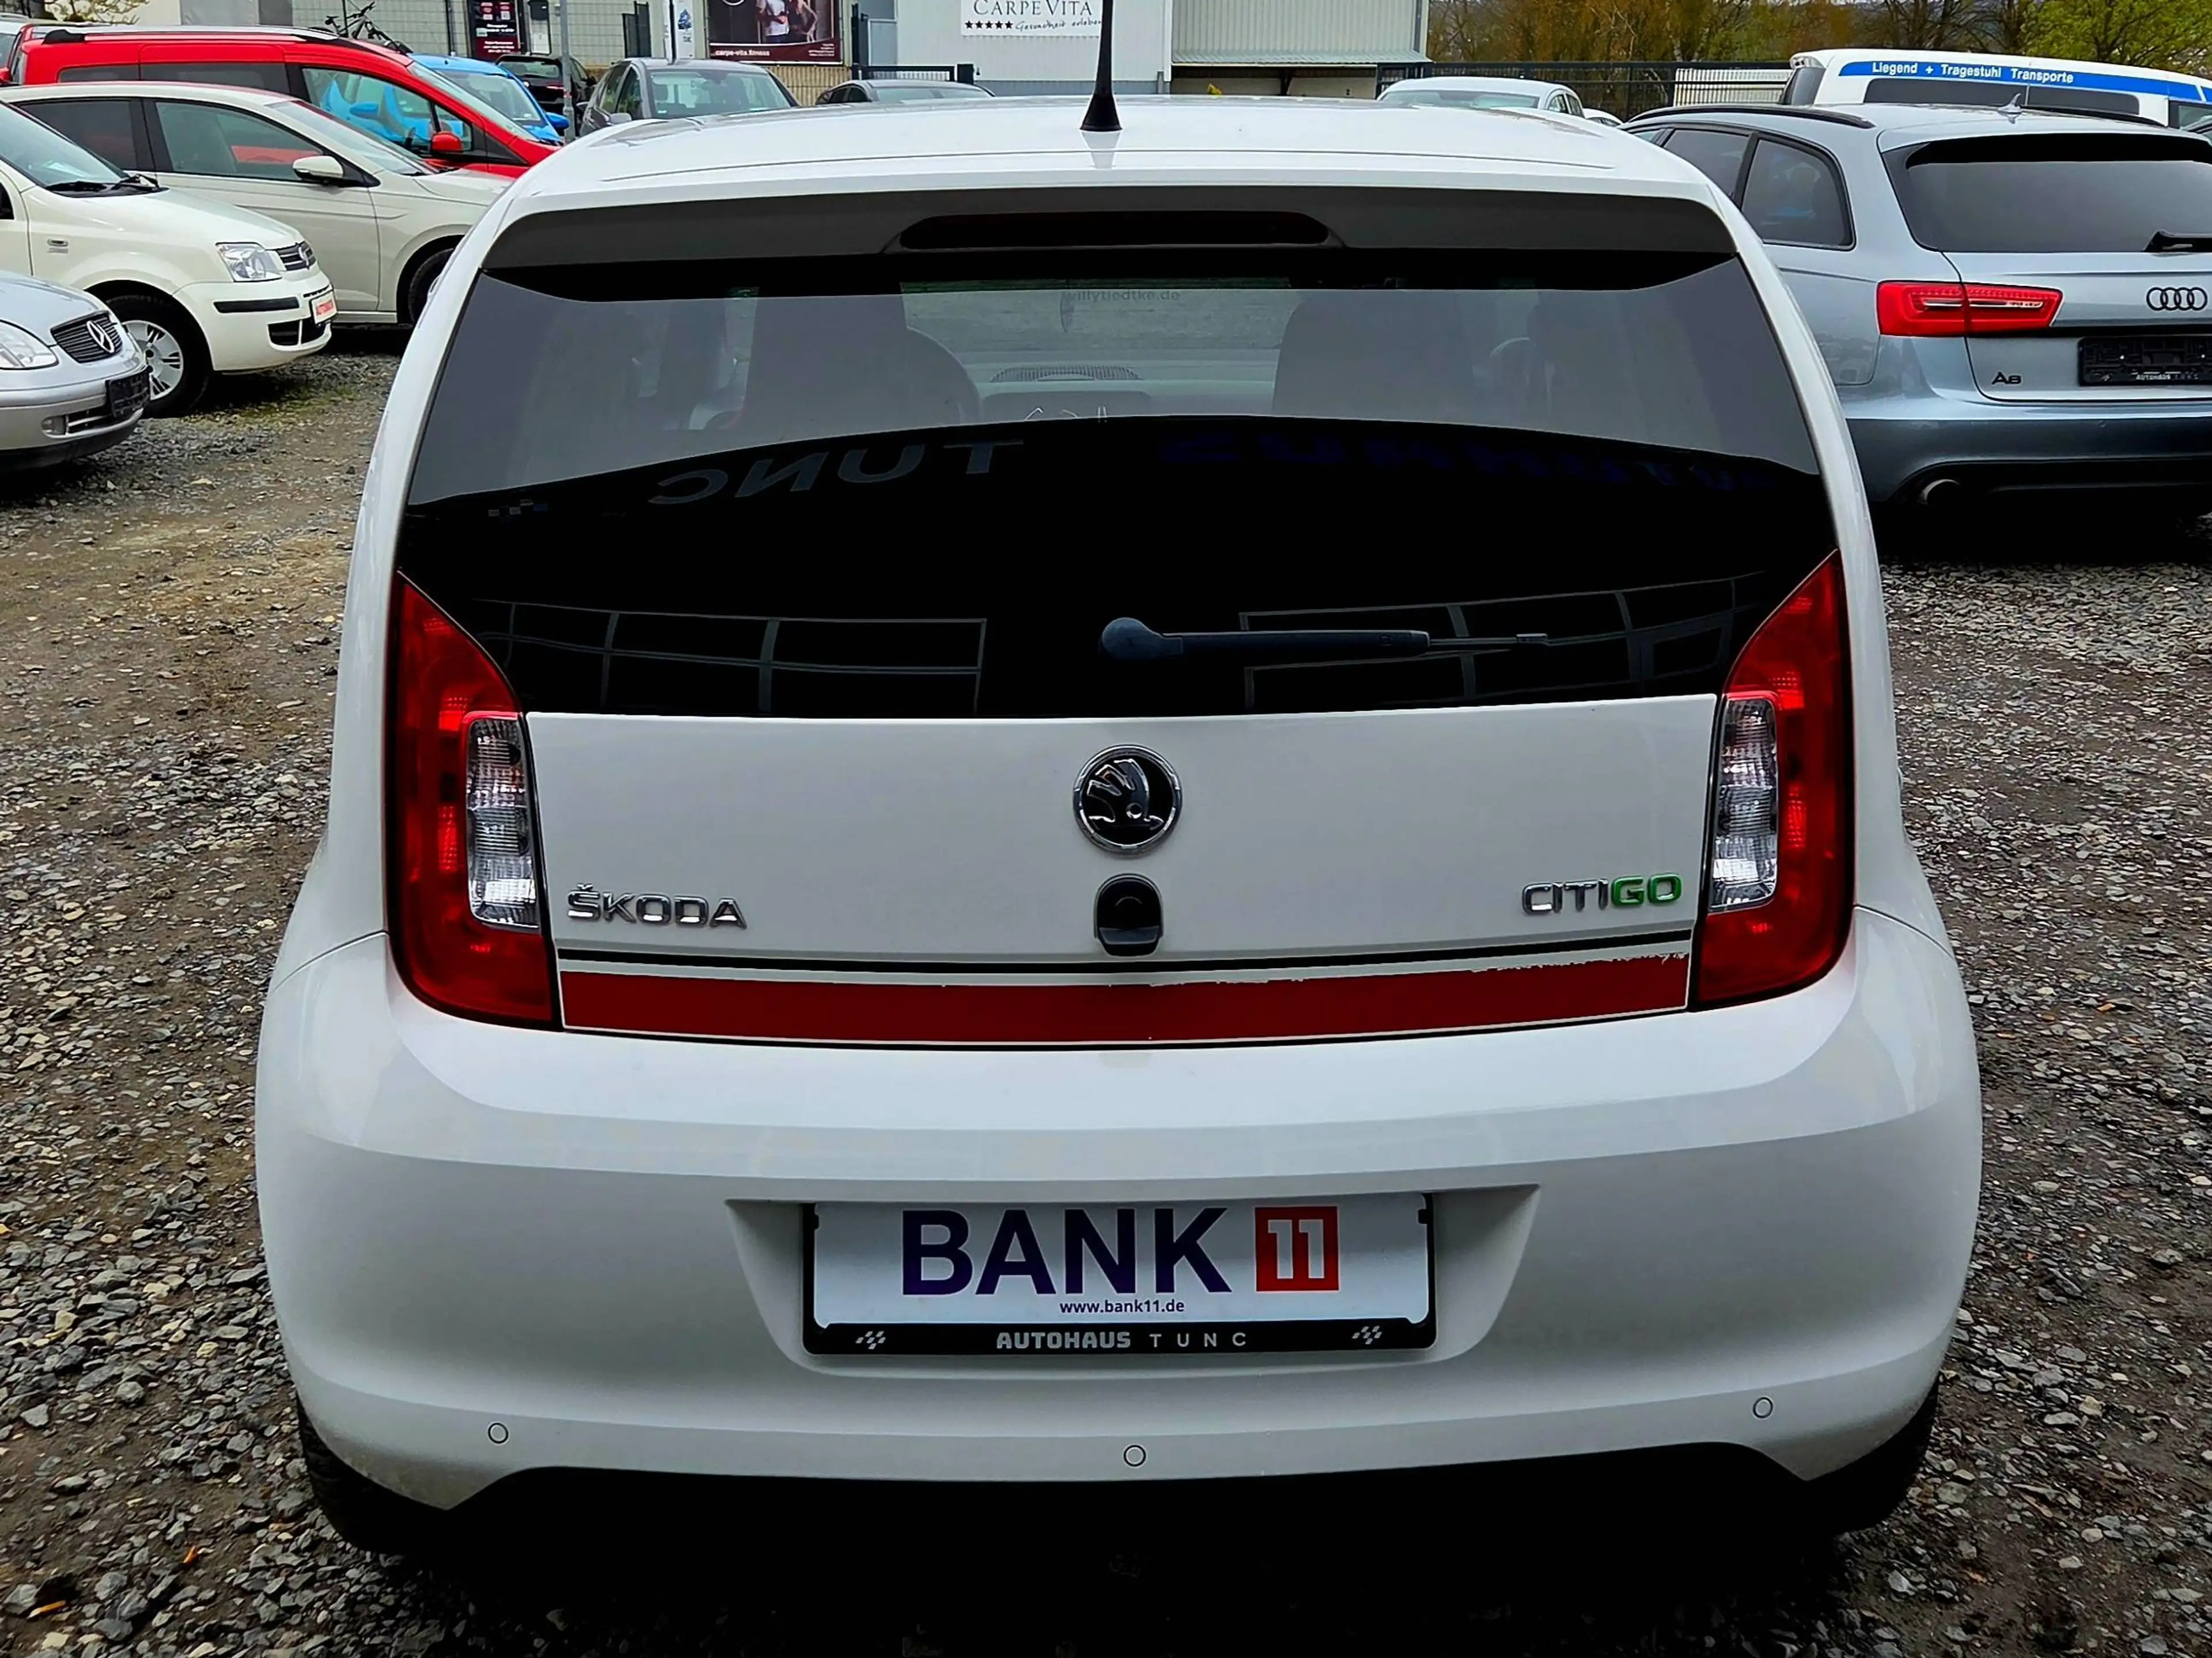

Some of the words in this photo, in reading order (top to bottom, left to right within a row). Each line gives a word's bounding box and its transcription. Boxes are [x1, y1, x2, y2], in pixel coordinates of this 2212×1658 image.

[1872, 62, 1918, 76] Liegend
[1941, 63, 2001, 78] Tragestuhl
[2010, 67, 2074, 84] Transporte
[567, 882, 747, 929] ŠKODA
[1522, 872, 1682, 915] CITIGO
[902, 1207, 1233, 1296] BANK
[1267, 1219, 1324, 1279] 11
[1059, 1299, 1185, 1314] www.bank11.de
[997, 1331, 1131, 1349] AUTOHAUS
[1149, 1332, 1247, 1348] TUNC
